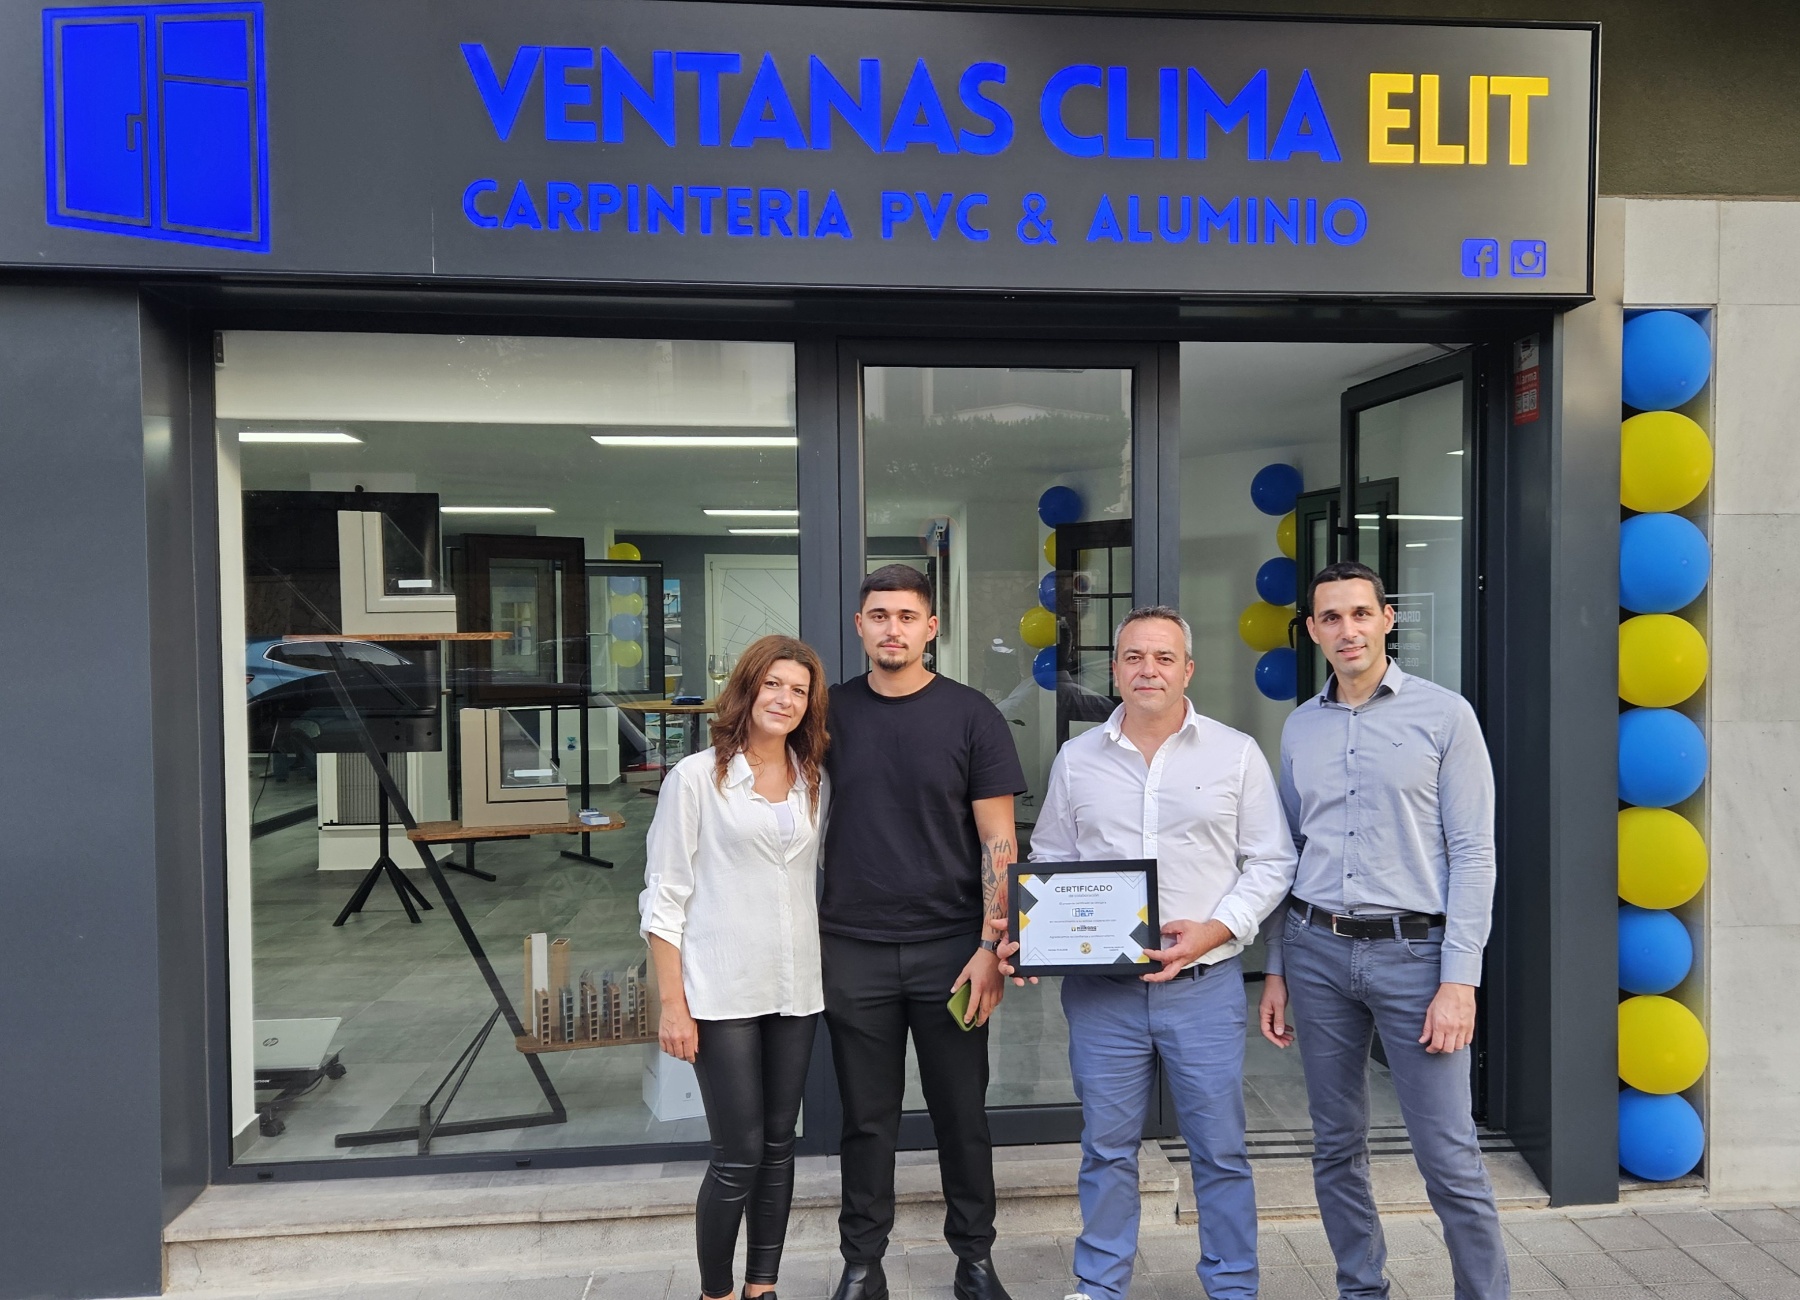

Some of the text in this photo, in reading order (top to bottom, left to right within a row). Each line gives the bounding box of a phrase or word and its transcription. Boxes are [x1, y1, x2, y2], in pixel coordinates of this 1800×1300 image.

[460, 43, 1550, 167] VENTANAS CLIMA ELIT
[463, 179, 1368, 245] CARPINTERIA PVC & ALUMINIO
[1394, 610, 1421, 623] ORARIO
[993, 838, 1012, 856] HA
[1054, 884, 1113, 893] CERTIFICADO
